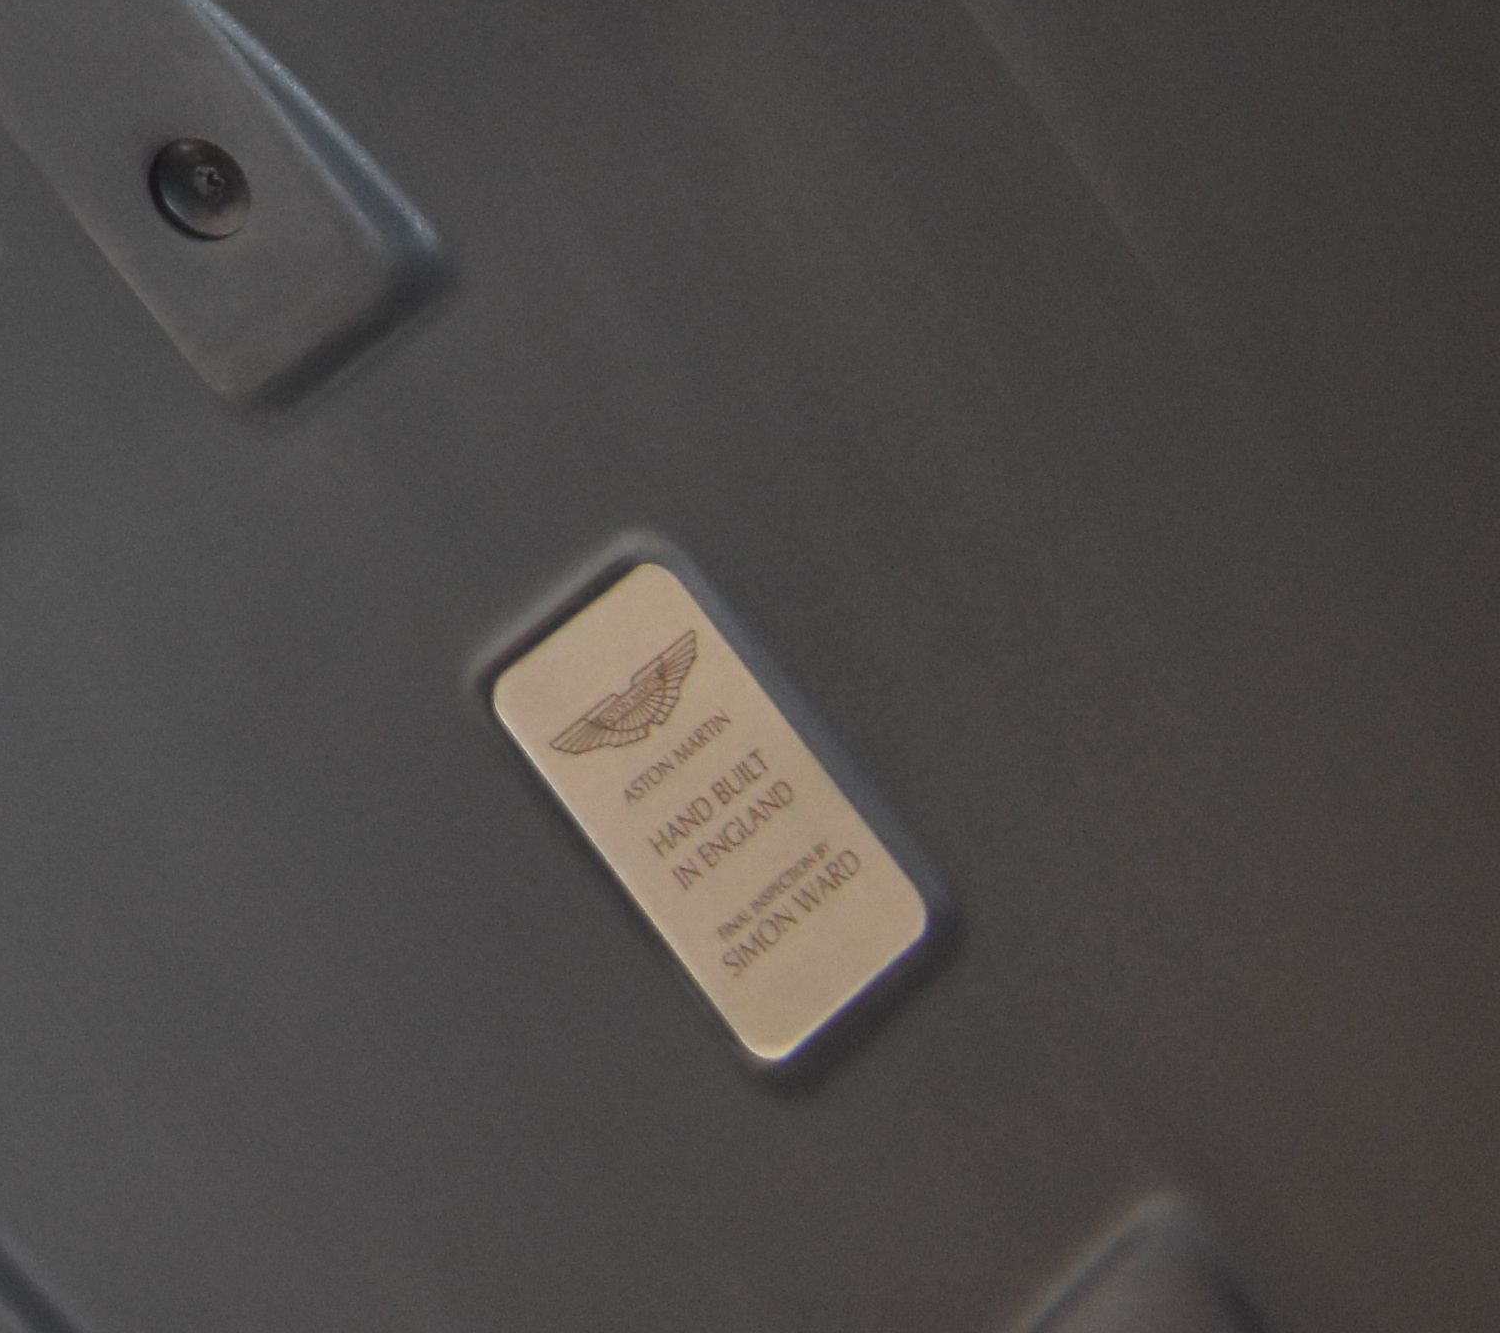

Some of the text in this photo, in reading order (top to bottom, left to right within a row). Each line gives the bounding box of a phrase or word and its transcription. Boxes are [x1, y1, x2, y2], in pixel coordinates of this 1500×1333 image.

[623, 709, 731, 804] ASTON MARTIN
[648, 748, 769, 858] HAND BUILT
[672, 780, 795, 891] IN ENGLAND
[722, 849, 861, 978] SIMON WARD
